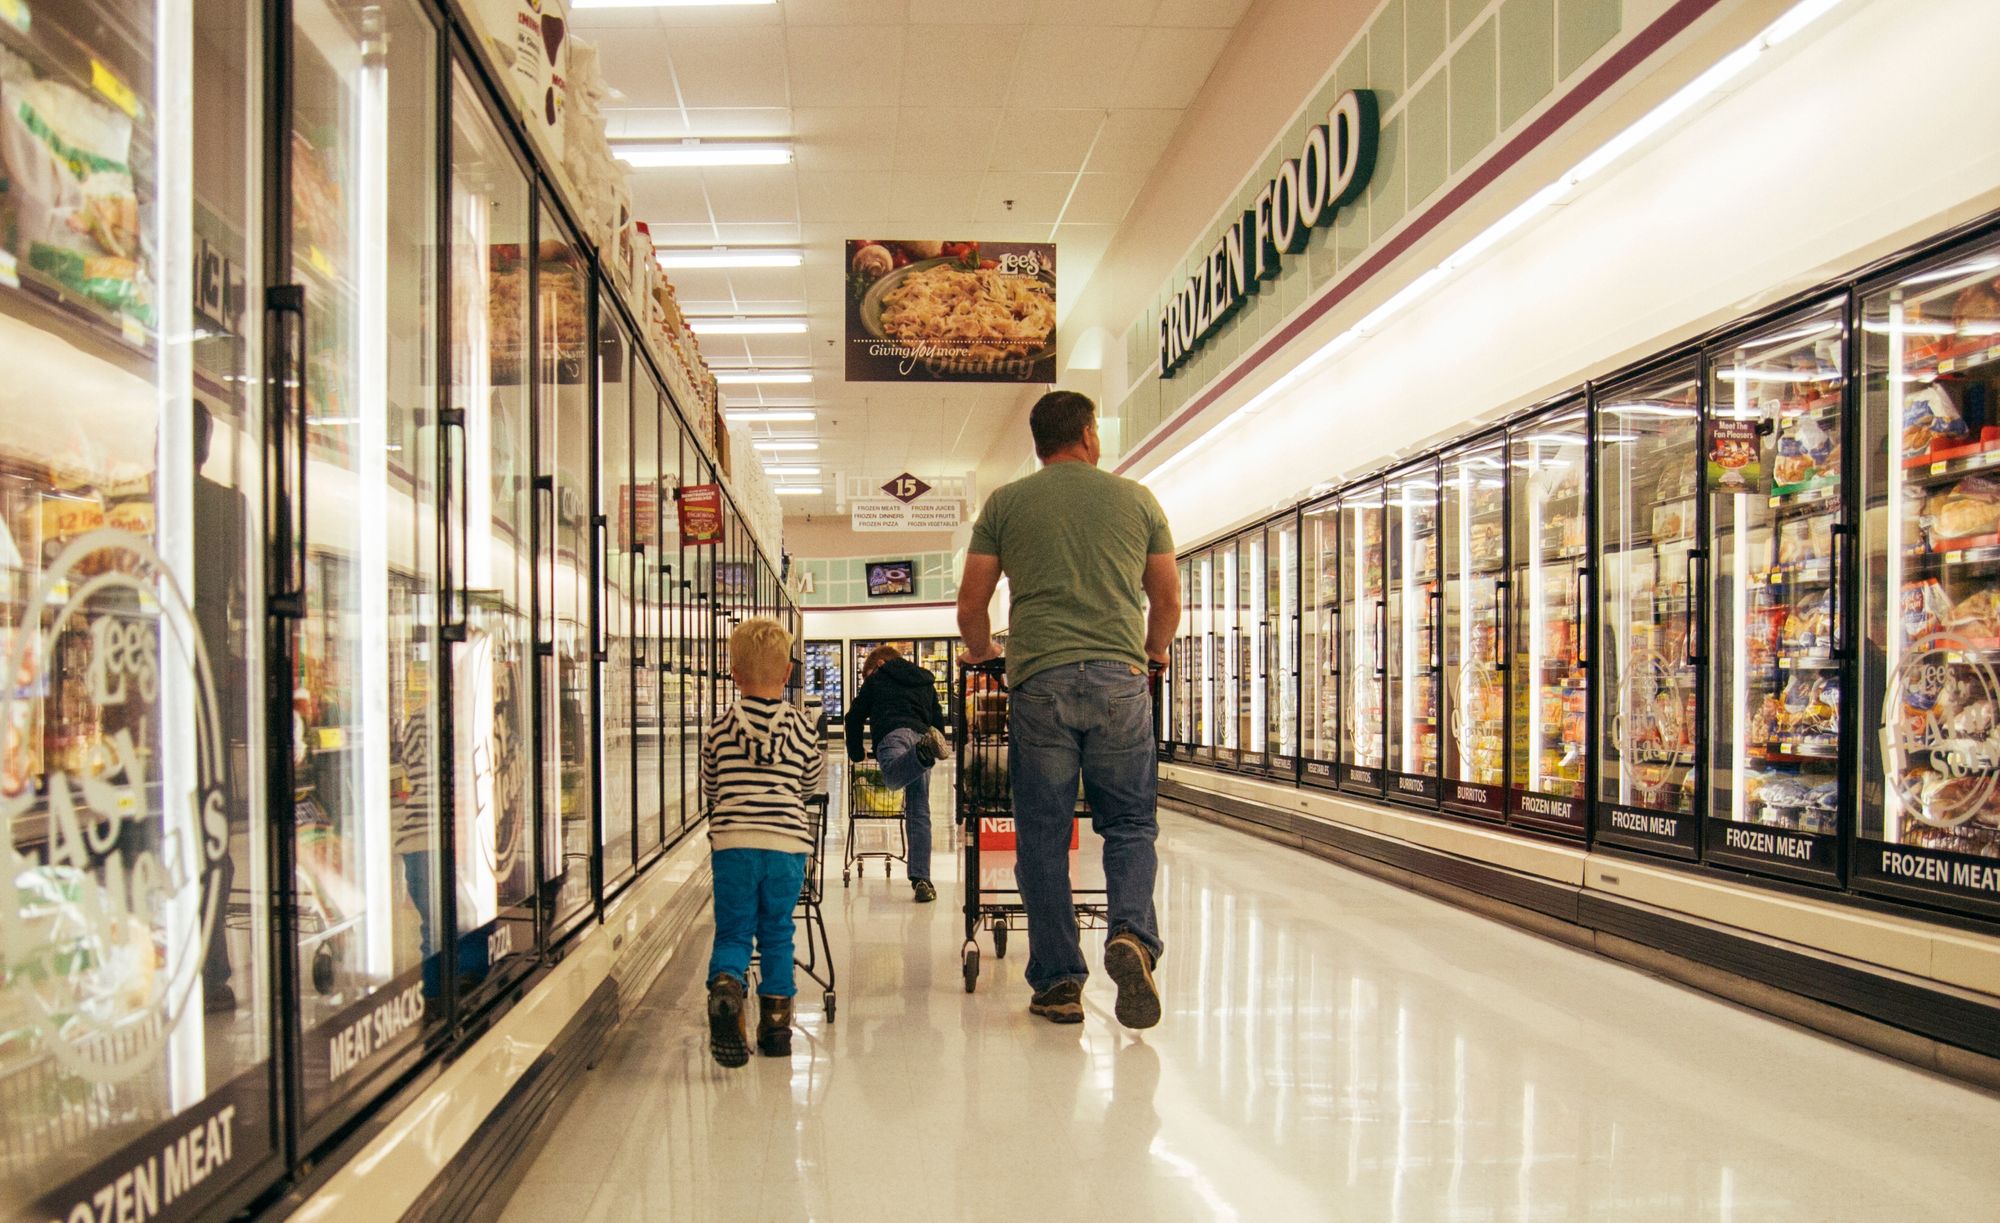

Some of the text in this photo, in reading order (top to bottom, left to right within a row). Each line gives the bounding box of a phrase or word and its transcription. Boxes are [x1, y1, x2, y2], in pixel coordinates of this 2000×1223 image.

[1158, 89, 1377, 378] FROZEN FOOD
[869, 340, 972, 375] Giving you more.
[1719, 421, 1748, 430] Meet The
[1726, 430, 1754, 439] Pleasers
[895, 478, 917, 497] 15
[1307, 761, 1330, 776] VEGETABLES
[1350, 768, 1372, 783] BURRITOS
[1399, 777, 1424, 792] BURRITOS
[1457, 786, 1487, 804] BURRITOS
[1521, 796, 1572, 819] FROZEN MEAT
[1612, 811, 1677, 837] FROZEN MEAT
[1726, 827, 1813, 861] FROZEN MEAT
[1882, 851, 2000, 893] FROZEN MEAT
[330, 980, 425, 1082] MEAT SNACKS
[164, 1104, 235, 1205] MEAT
